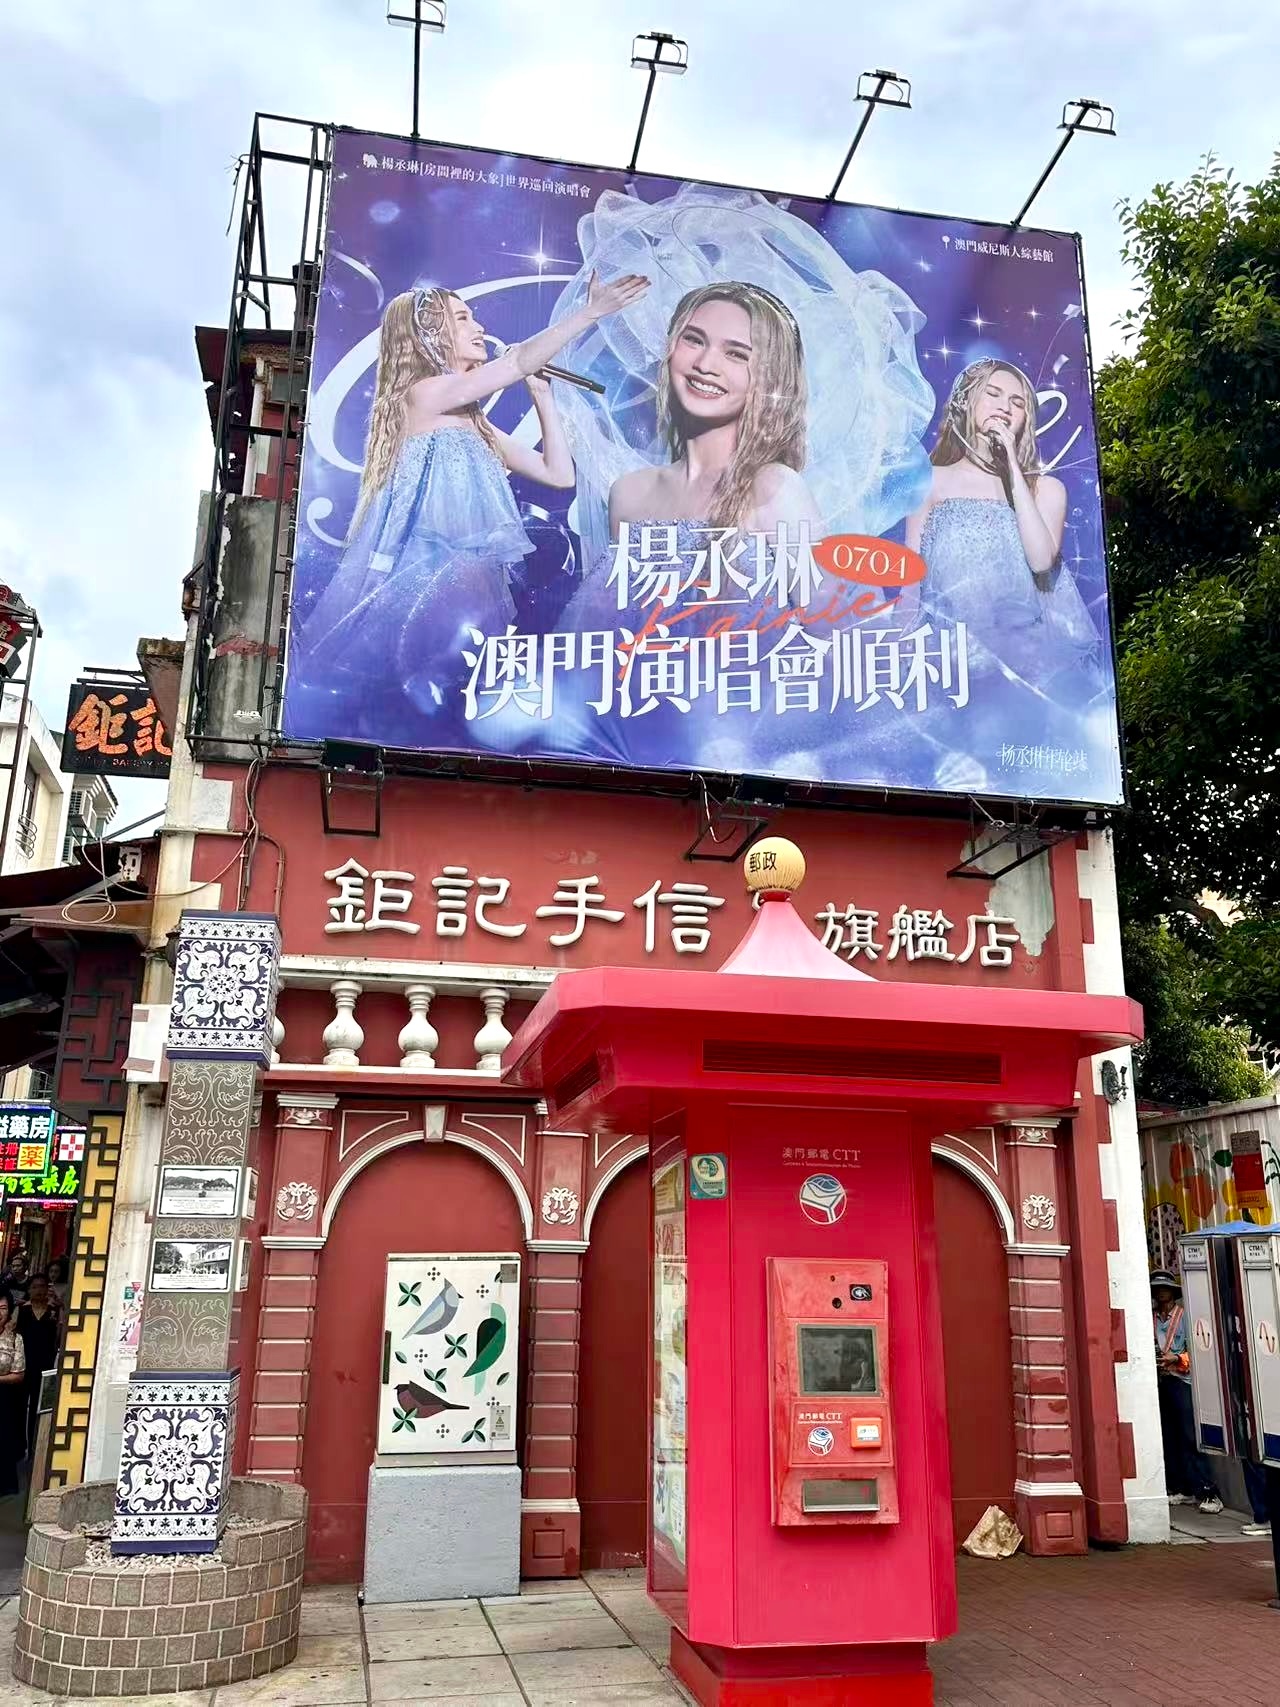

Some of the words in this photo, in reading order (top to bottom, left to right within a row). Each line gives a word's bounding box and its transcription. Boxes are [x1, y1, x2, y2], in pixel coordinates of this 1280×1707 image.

[954, 237, 1054, 263] 澳門威尼斯人綜藝館
[605, 519, 824, 610] 楊丞琳
[832, 543, 907, 579] 0704
[460, 620, 970, 721] 澳門演唱會順利
[749, 851, 777, 873] 郵政
[323, 856, 726, 954] 鉅記手信
[782, 1147, 830, 1161] 澳門郵電
[832, 1148, 861, 1161] CTT
[825, 1412, 842, 1421] CTT
